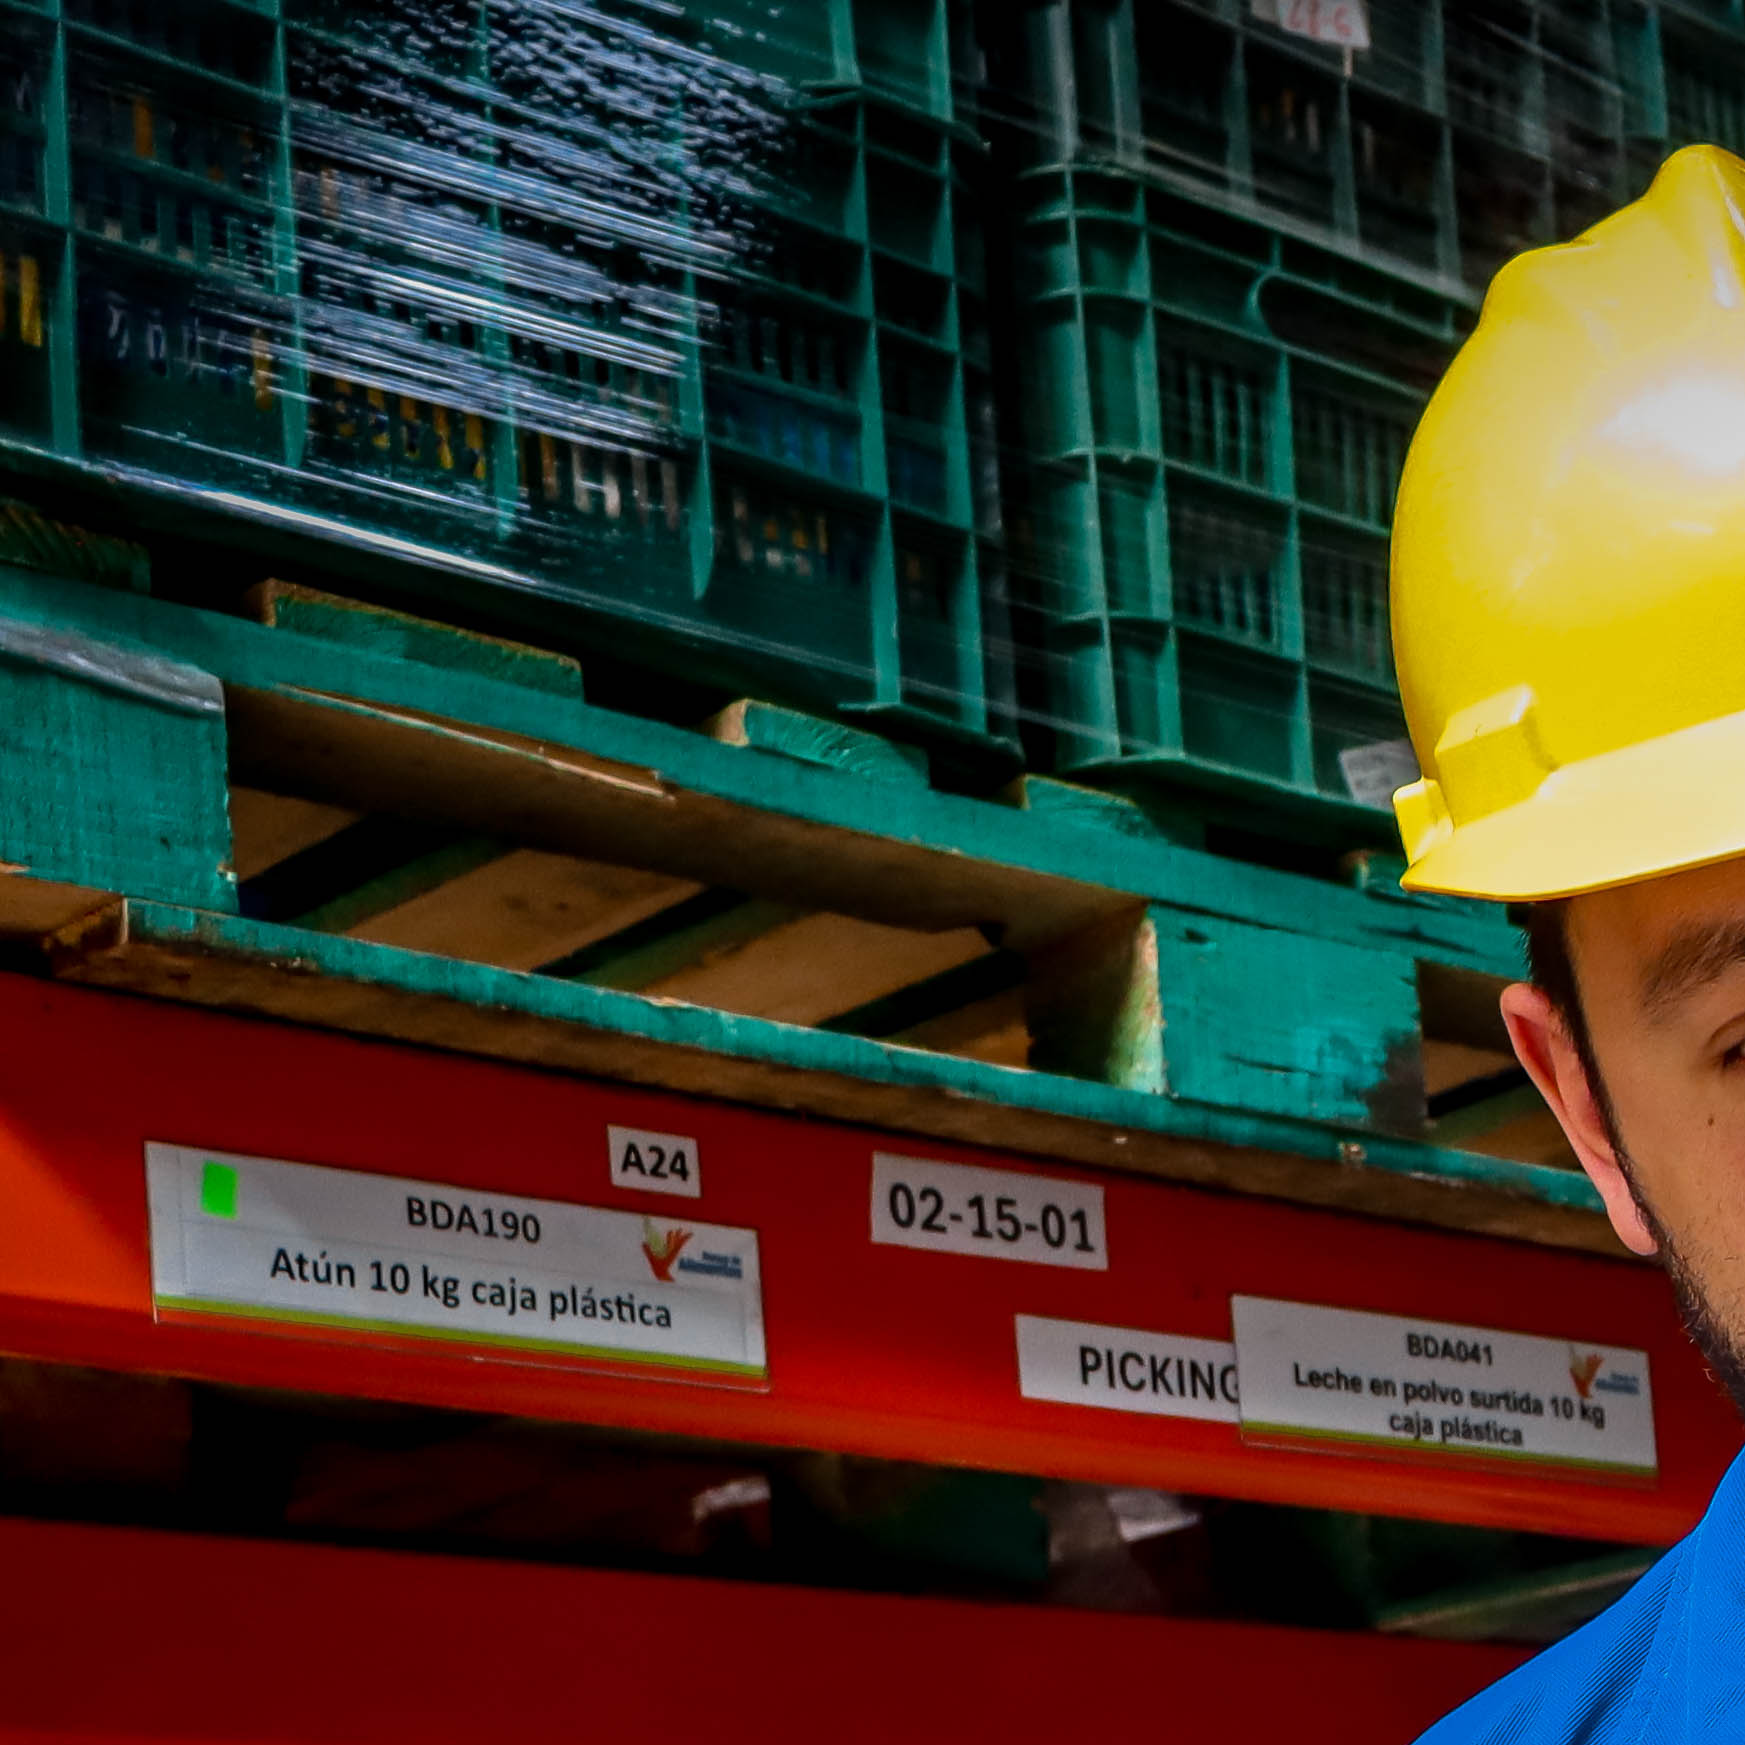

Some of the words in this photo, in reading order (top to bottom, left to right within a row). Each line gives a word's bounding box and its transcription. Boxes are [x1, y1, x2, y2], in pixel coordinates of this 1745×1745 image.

[620, 1141, 690, 1183] A24
[406, 1196, 542, 1245] BDA190
[889, 1182, 1096, 1253] 02-15-01
[270, 1247, 356, 1290] Atún
[370, 1260, 410, 1296] 10
[422, 1265, 461, 1308] kg
[472, 1278, 537, 1317] caja
[549, 1286, 672, 1329] plástica
[1079, 1345, 1240, 1404] PICKING
[1406, 1332, 1494, 1367] BDA041
[1293, 1362, 1363, 1394] Leche
[1370, 1373, 1397, 1398] en
[1403, 1380, 1464, 1407] polvo
[1470, 1386, 1545, 1418] surtida
[1551, 1396, 1576, 1421] 10
[1580, 1398, 1606, 1430] kg
[1388, 1411, 1436, 1441] caja
[1440, 1417, 1523, 1447] plástica
